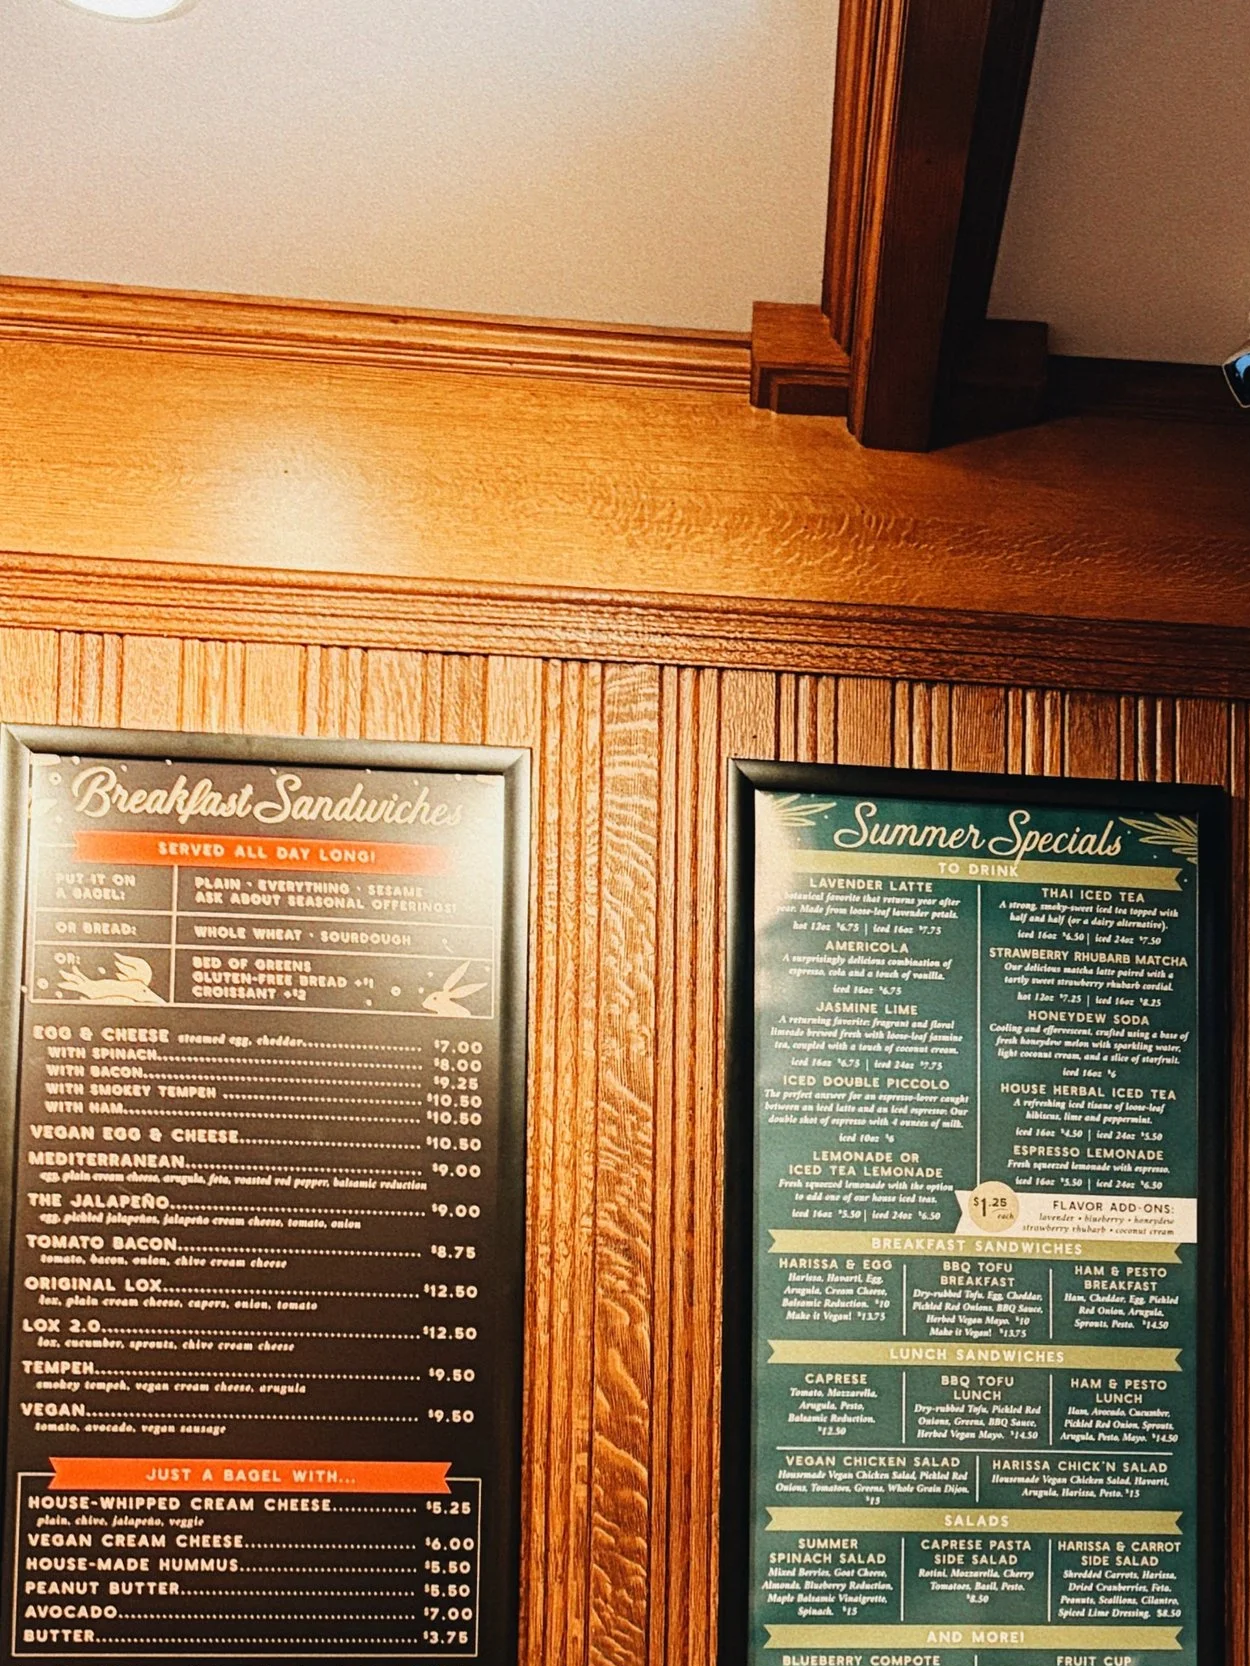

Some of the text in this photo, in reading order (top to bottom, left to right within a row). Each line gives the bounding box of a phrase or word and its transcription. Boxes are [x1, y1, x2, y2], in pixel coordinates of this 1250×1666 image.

[71, 765, 463, 828] Breakfast Sandwiches
[833, 801, 1123, 867] Summer Specials
[158, 841, 380, 865] SERVED ALL DAY LONG!
[937, 861, 1019, 879] TO DRINK
[194, 876, 423, 898] PLAIN EVERYTHING SESAME
[809, 876, 932, 892] LAVENDER LATTE
[1041, 887, 1144, 903] THAI ICED TEA
[194, 925, 411, 946] WHOLE WHEAT SOURDOUGH
[825, 940, 909, 953] AMERICOLA
[989, 947, 1187, 967] STRAWBERRY RHUBARB MATCHA
[1028, 1010, 1149, 1025] HONEYDEW SODA
[29, 1024, 72, 1040] EGG
[79, 1026, 93, 1041] &
[100, 1027, 169, 1043] CHEESE
[433, 1039, 483, 1054] $7.00
[782, 1072, 949, 1090] ICED DOUBLE PICCOLO
[1000, 1082, 1176, 1100] HOUSE HERBAL ICED TEA
[29, 1124, 481, 1151] VEGAN EGG & CHEESE $10.50
[1013, 1144, 1163, 1160] ESPRESSO LEMONADE
[28, 1150, 480, 1178] MEDITERRANEAN $9.00
[973, 1197, 1007, 1217] $1.25
[1053, 1200, 1102, 1211] FLAVOR
[25, 1234, 475, 1259] TOMATO BACON $8.75
[871, 1237, 1082, 1256] BREAKFAST SANDWICHES
[779, 1257, 892, 1270] HARISSA & EGG
[1074, 1265, 1167, 1278] HAM & PESTO
[22, 1318, 477, 1340] LOX 2.0 $12.50
[889, 1347, 1064, 1363] LUNCH SANDWICHES
[804, 1373, 867, 1385] CAPRESE
[20, 1402, 474, 1423] VEGAN $9.50
[785, 1455, 960, 1467] VEGAN CHICKEN SALAD
[992, 1459, 1167, 1473] HARISSA CHICK'N SALAD
[145, 1467, 191, 1481] JUST
[202, 1468, 213, 1481] A
[223, 1468, 281, 1482] BAGEL
[28, 1495, 470, 1514] HOUSE-WHIPPED CREAM CHEESE $5.25
[944, 1514, 1008, 1527] SALADS
[26, 1557, 470, 1574] HOUSE-MADE HUMMUS $5.50
[24, 1604, 472, 1620] AVOCADO $7.00
[926, 1630, 1024, 1644] AND MORE!
[782, 1655, 940, 1666] BLUEBERRY COMPOTE
[1056, 1655, 1132, 1666] FRUIT CUP
